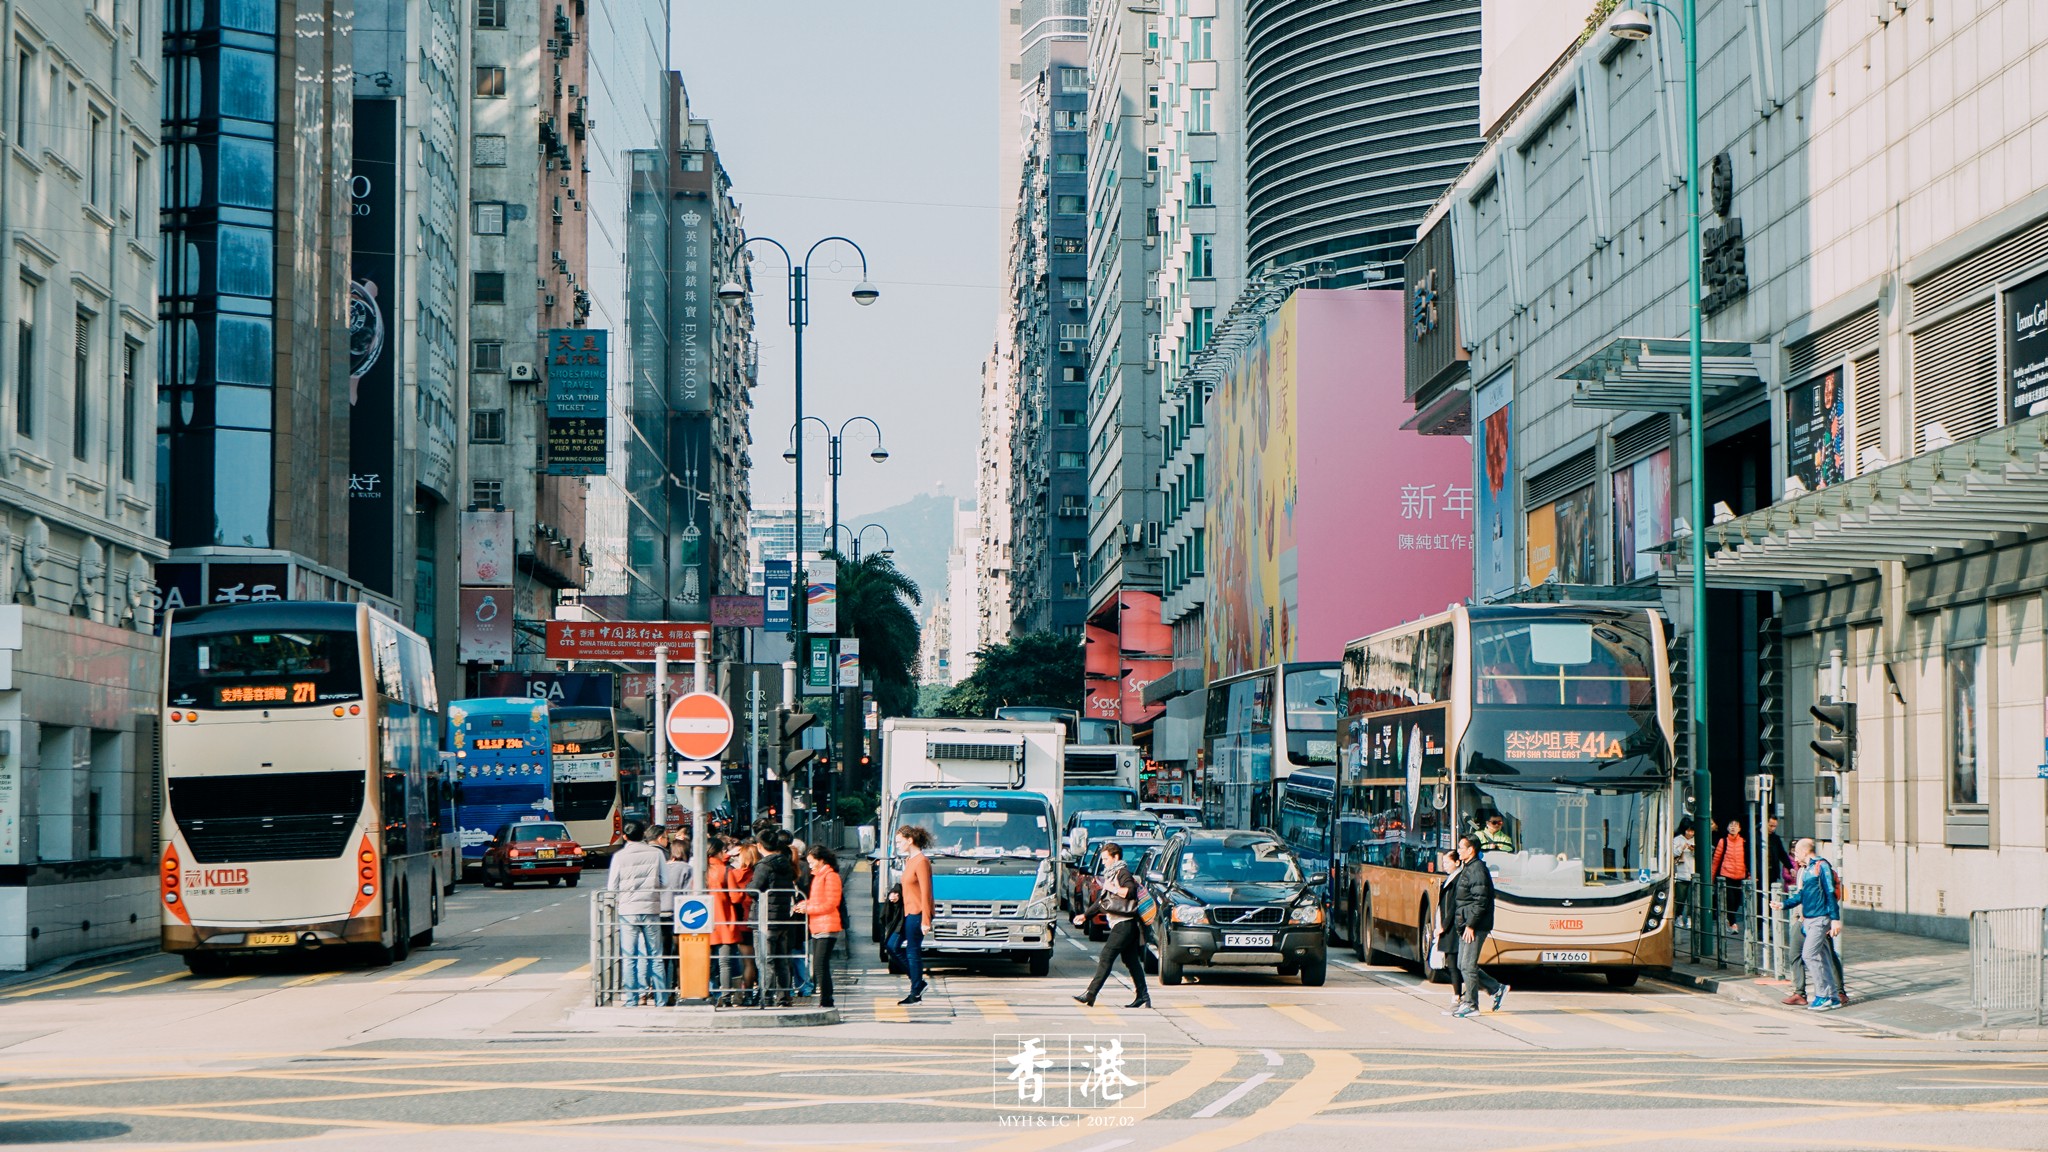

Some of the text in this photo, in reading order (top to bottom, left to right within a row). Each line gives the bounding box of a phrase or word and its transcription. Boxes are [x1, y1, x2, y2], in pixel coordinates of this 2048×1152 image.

[685, 323, 697, 400] EMPEROR
[550, 370, 606, 379] SHOESTRING
[561, 380, 594, 389] TRAVEL
[348, 474, 380, 491] 太子
[1401, 483, 1473, 520] 新年
[579, 629, 595, 638] 香港
[669, 630, 696, 639] 有限公
[292, 682, 316, 703] 271
[526, 681, 565, 699] ISA
[566, 743, 581, 753] 41A
[1506, 730, 1623, 759] 尖沙咀東 41A
[1506, 750, 1581, 759] TSIM SHA TSUI EAST
[955, 867, 990, 875] ISUZU
[205, 868, 249, 887] KMB
[966, 921, 978, 929] JC
[1559, 919, 1584, 930] KMB
[962, 929, 979, 937] 324
[254, 935, 290, 944] UJ 773
[1227, 936, 1271, 945] FX 5956
[1545, 952, 1588, 961] TW 2660
